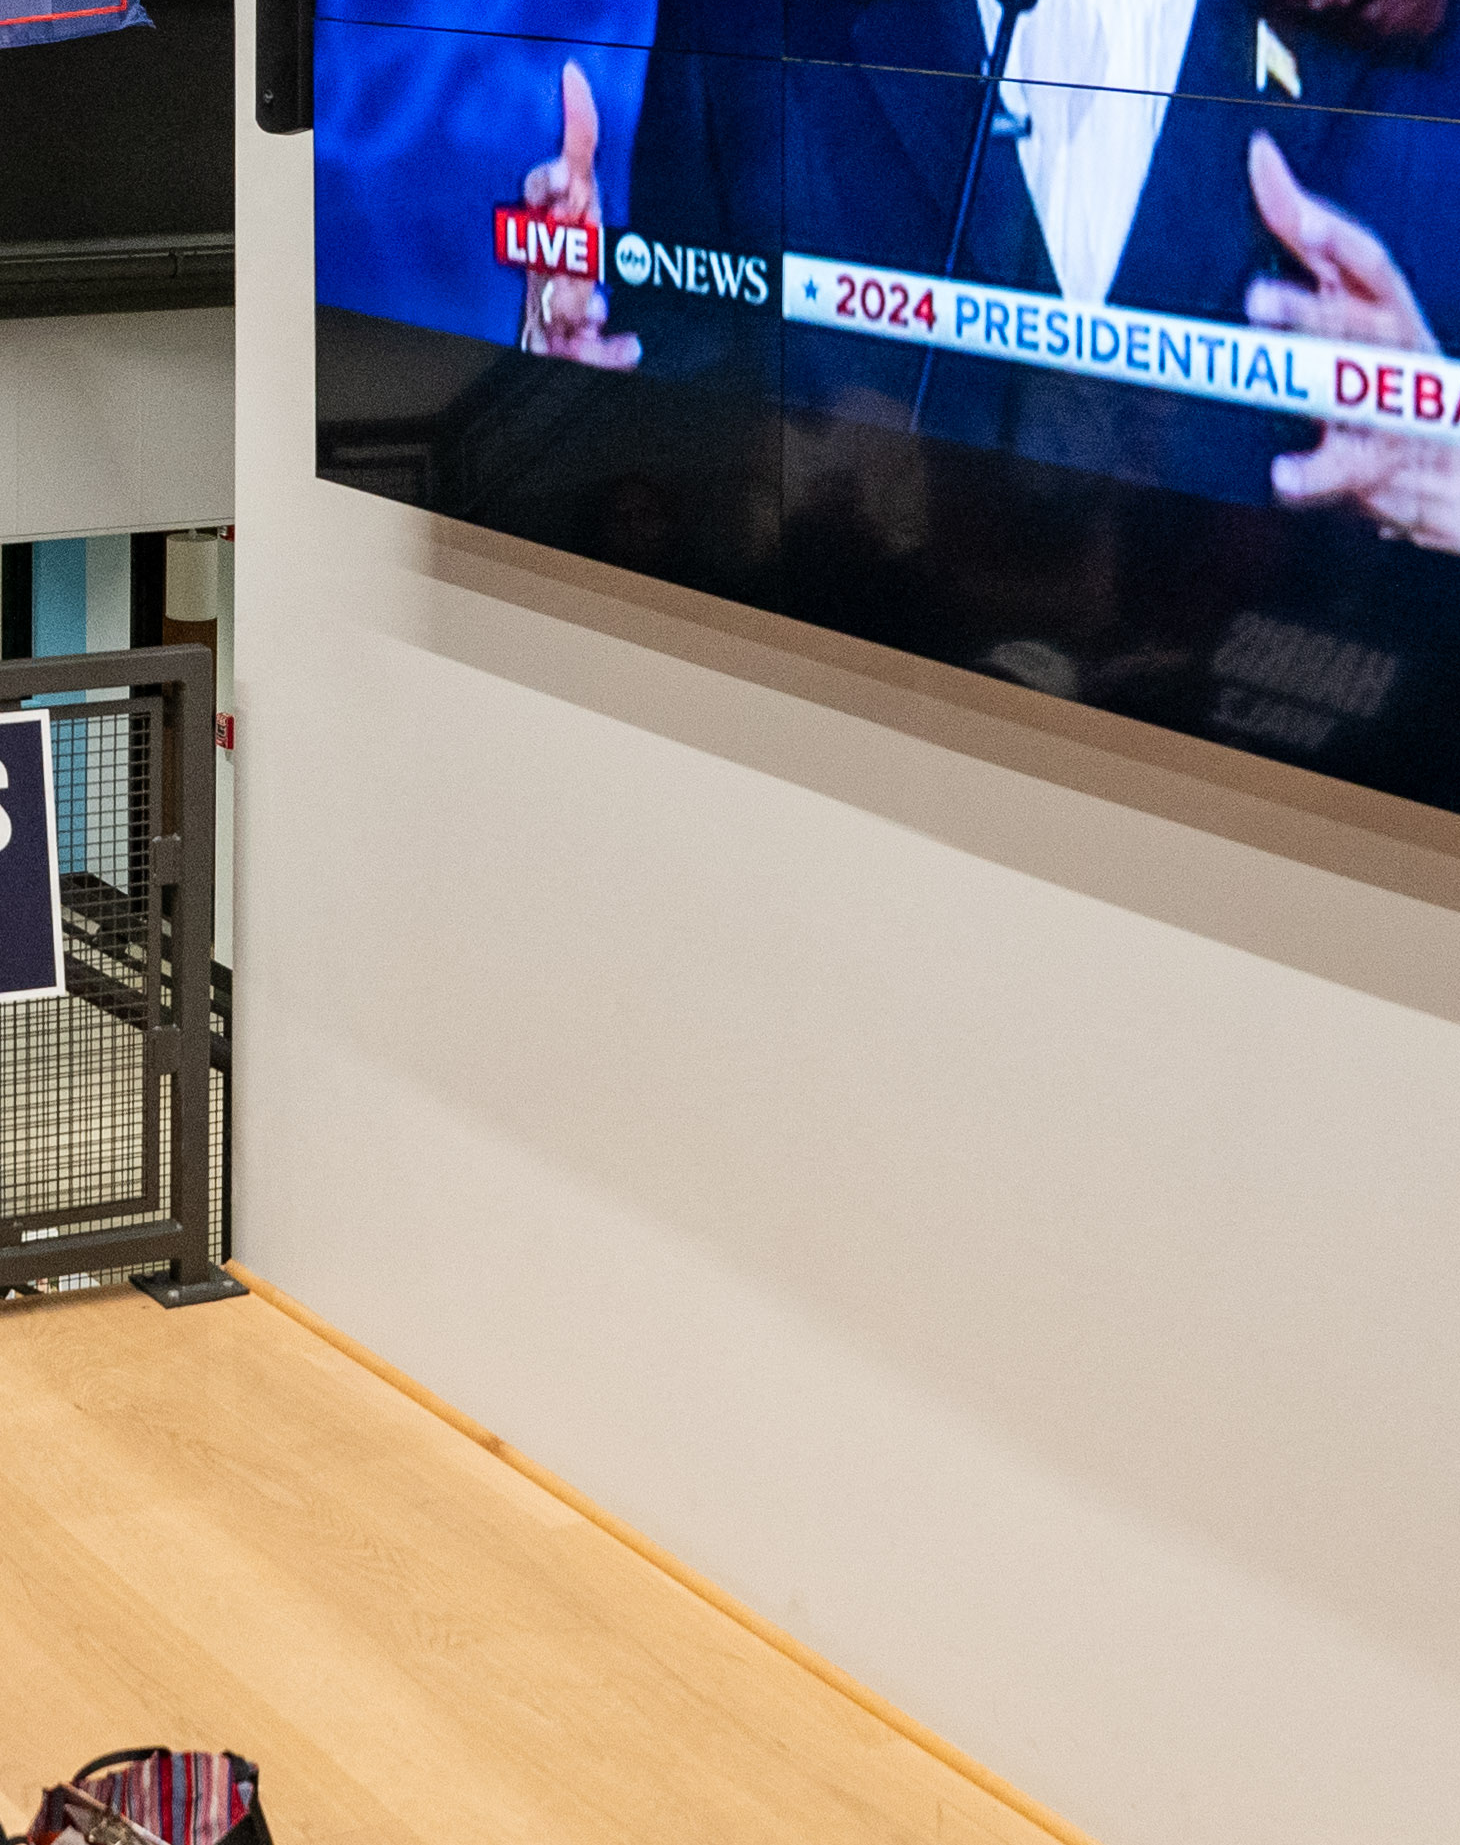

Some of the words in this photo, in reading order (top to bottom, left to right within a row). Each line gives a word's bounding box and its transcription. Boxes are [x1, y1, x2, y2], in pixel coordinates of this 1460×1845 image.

[505, 217, 589, 273] LIVE
[652, 241, 770, 306] NEWS
[834, 274, 937, 332] 2024
[955, 294, 1310, 403] PRESIDENTIAL
